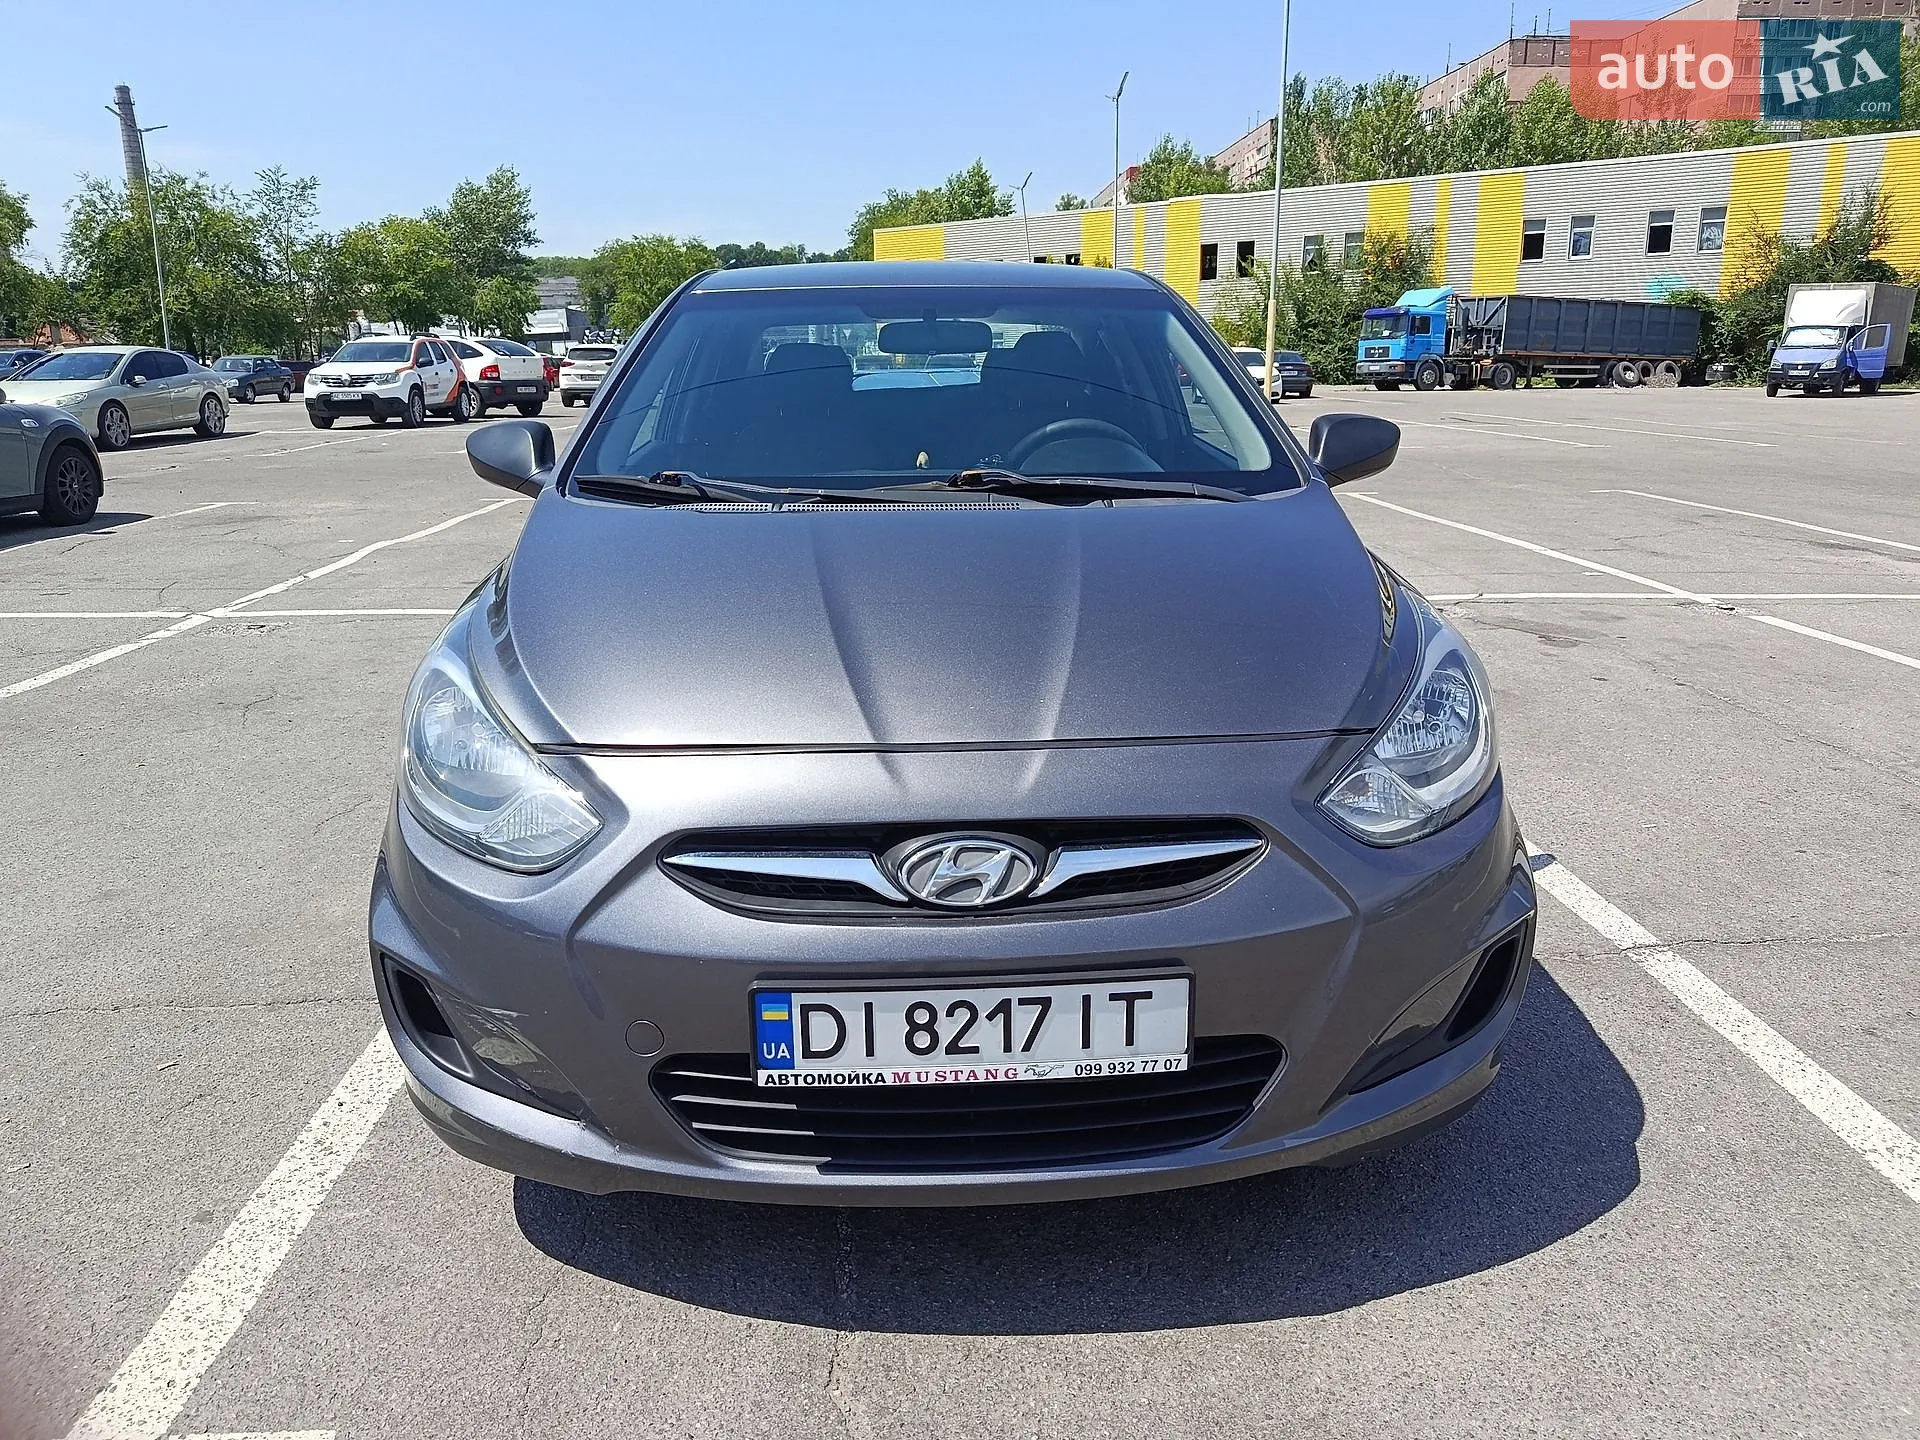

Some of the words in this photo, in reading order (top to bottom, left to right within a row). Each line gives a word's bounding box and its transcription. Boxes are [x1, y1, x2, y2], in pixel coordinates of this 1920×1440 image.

[800, 1002, 874, 1059] DI
[904, 996, 1052, 1056] 8217
[1081, 991, 1153, 1048] IT
[763, 1043, 790, 1060] UA
[764, 1071, 886, 1086] АВТОМОЙКА
[891, 1067, 1018, 1084] MUSTANG
[1074, 1063, 1102, 1076] 099
[1107, 1061, 1135, 1075] 932
[1140, 1060, 1158, 1074] 77
[1163, 1058, 1182, 1072] 07
